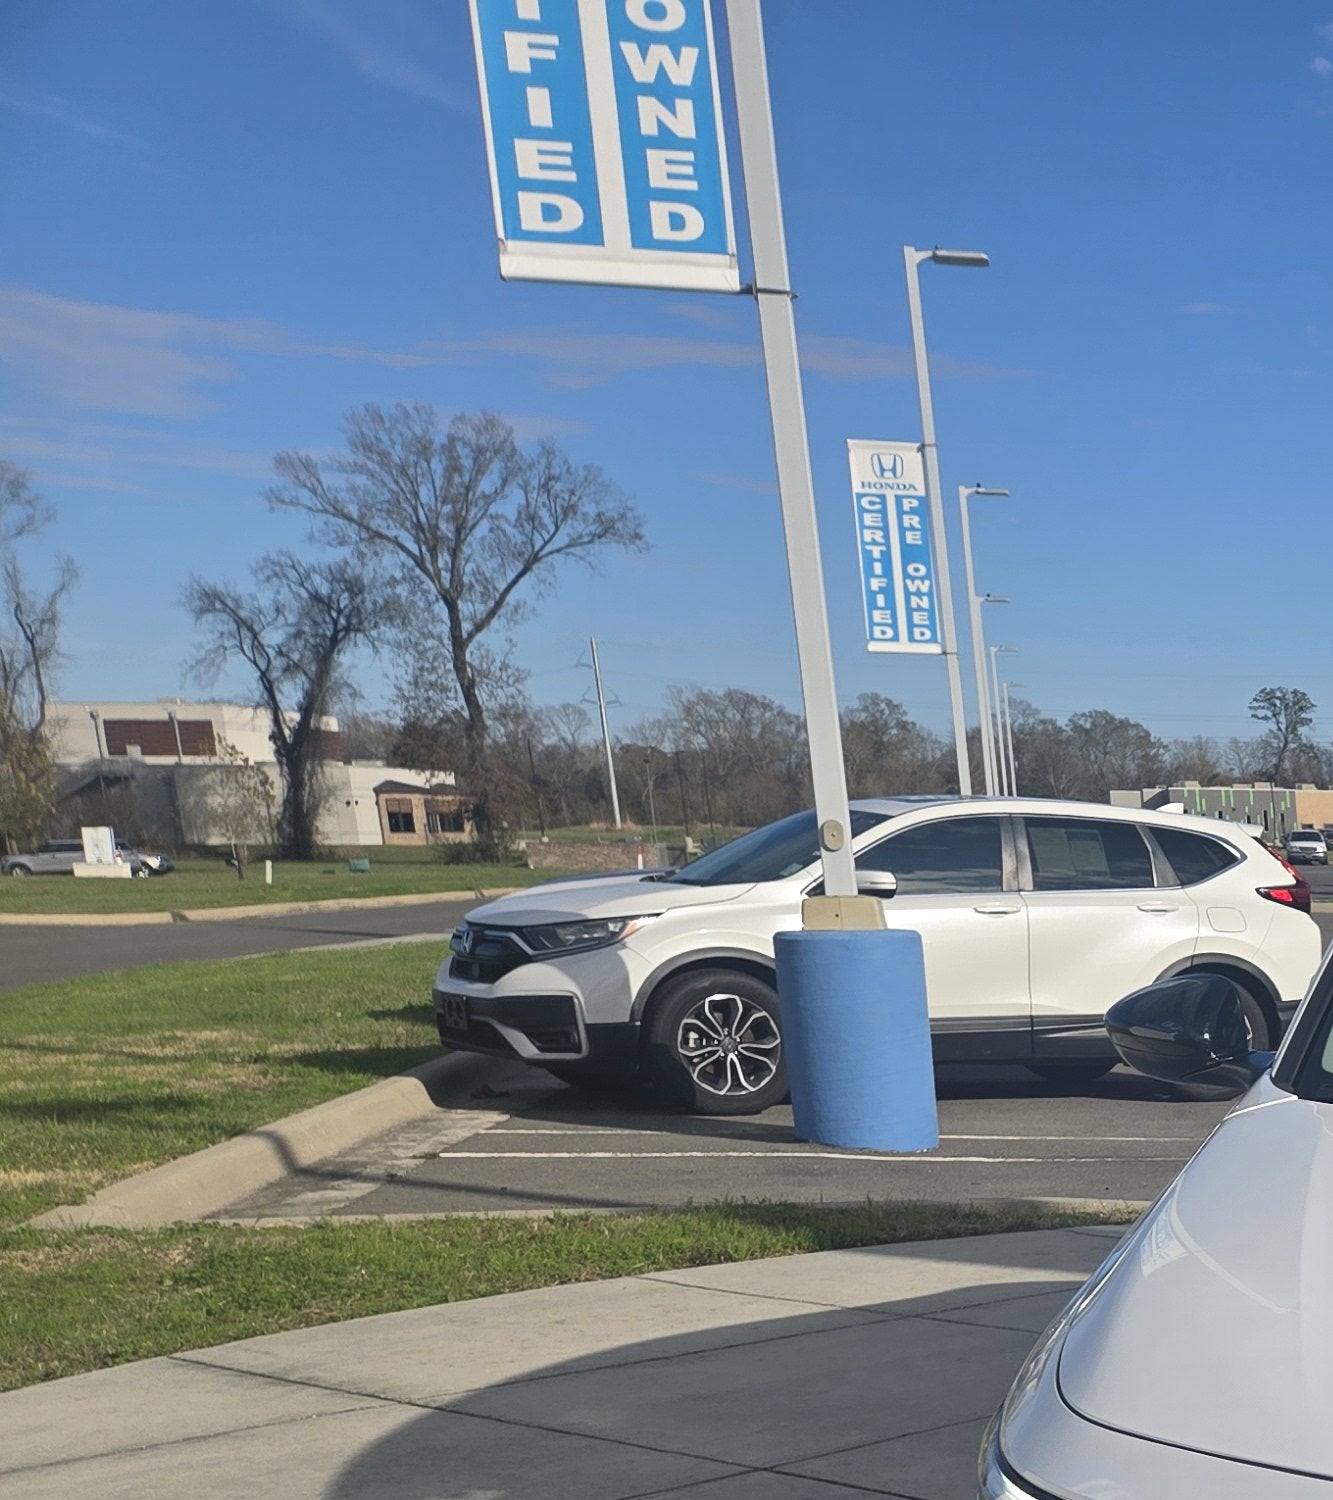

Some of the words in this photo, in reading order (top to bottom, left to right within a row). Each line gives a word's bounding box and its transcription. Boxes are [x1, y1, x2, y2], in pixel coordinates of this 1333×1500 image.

[619, 0, 705, 242] OWNED
[860, 480, 918, 492] HONDA
[902, 498, 923, 545] PRE
[860, 496, 894, 640] CERTIFIED
[905, 563, 932, 641] OWNED
